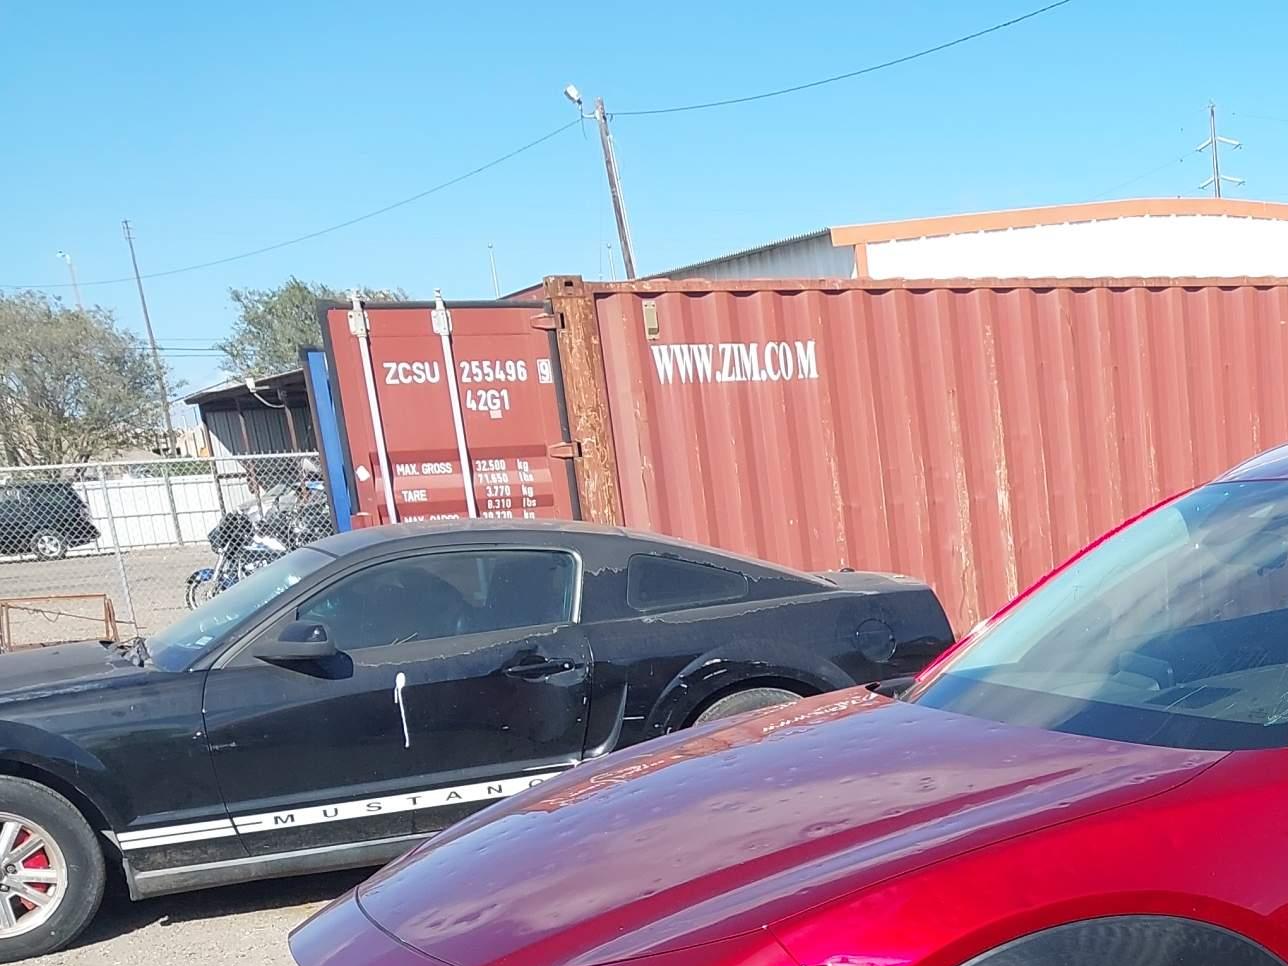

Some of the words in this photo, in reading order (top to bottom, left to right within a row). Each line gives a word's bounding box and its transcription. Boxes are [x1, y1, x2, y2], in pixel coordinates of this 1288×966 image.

[651, 340, 819, 385] WWW.ZIM.COM
[383, 361, 440, 385] ZCSU
[459, 360, 528, 383] 255496
[538, 361, 551, 382] 9
[466, 389, 510, 411] 42G1
[396, 463, 418, 476] MAX.
[421, 462, 453, 475] GROSS
[475, 459, 506, 472] 32.500
[516, 458, 529, 473] kg
[518, 472, 534, 483] lbs
[401, 489, 427, 502] TARE
[486, 485, 511, 498] 3.770
[521, 484, 534, 498] kg
[487, 498, 512, 510] 8.310
[522, 497, 537, 508] lbs
